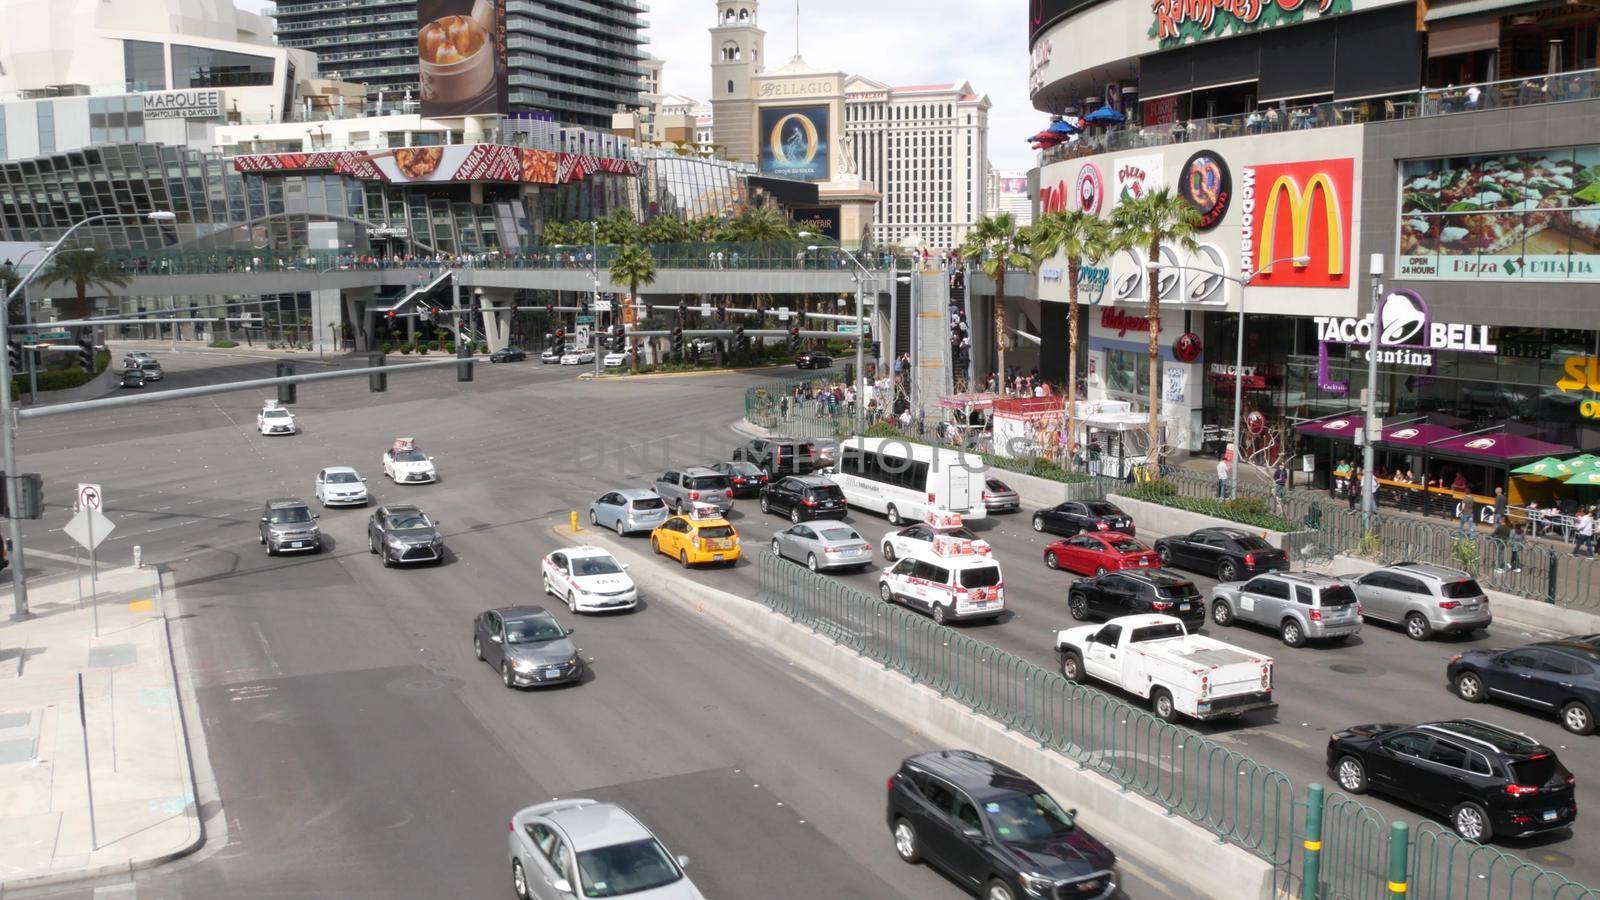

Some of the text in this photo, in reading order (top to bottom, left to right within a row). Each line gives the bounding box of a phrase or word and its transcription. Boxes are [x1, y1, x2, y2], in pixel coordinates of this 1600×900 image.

[757, 82, 833, 97] BELLAGIO
[143, 92, 218, 108] MARQUEE
[144, 110, 181, 118] NIGHTCLUB
[187, 108, 218, 116] DAYCLUB
[1409, 258, 1429, 266] OPEN
[1453, 259, 1498, 273] Pizza
[1402, 266, 1436, 275] 24 HOURS
[1314, 317, 1372, 343] TACO
[1430, 323, 1497, 352] BELL
[1365, 350, 1433, 367] cantina
